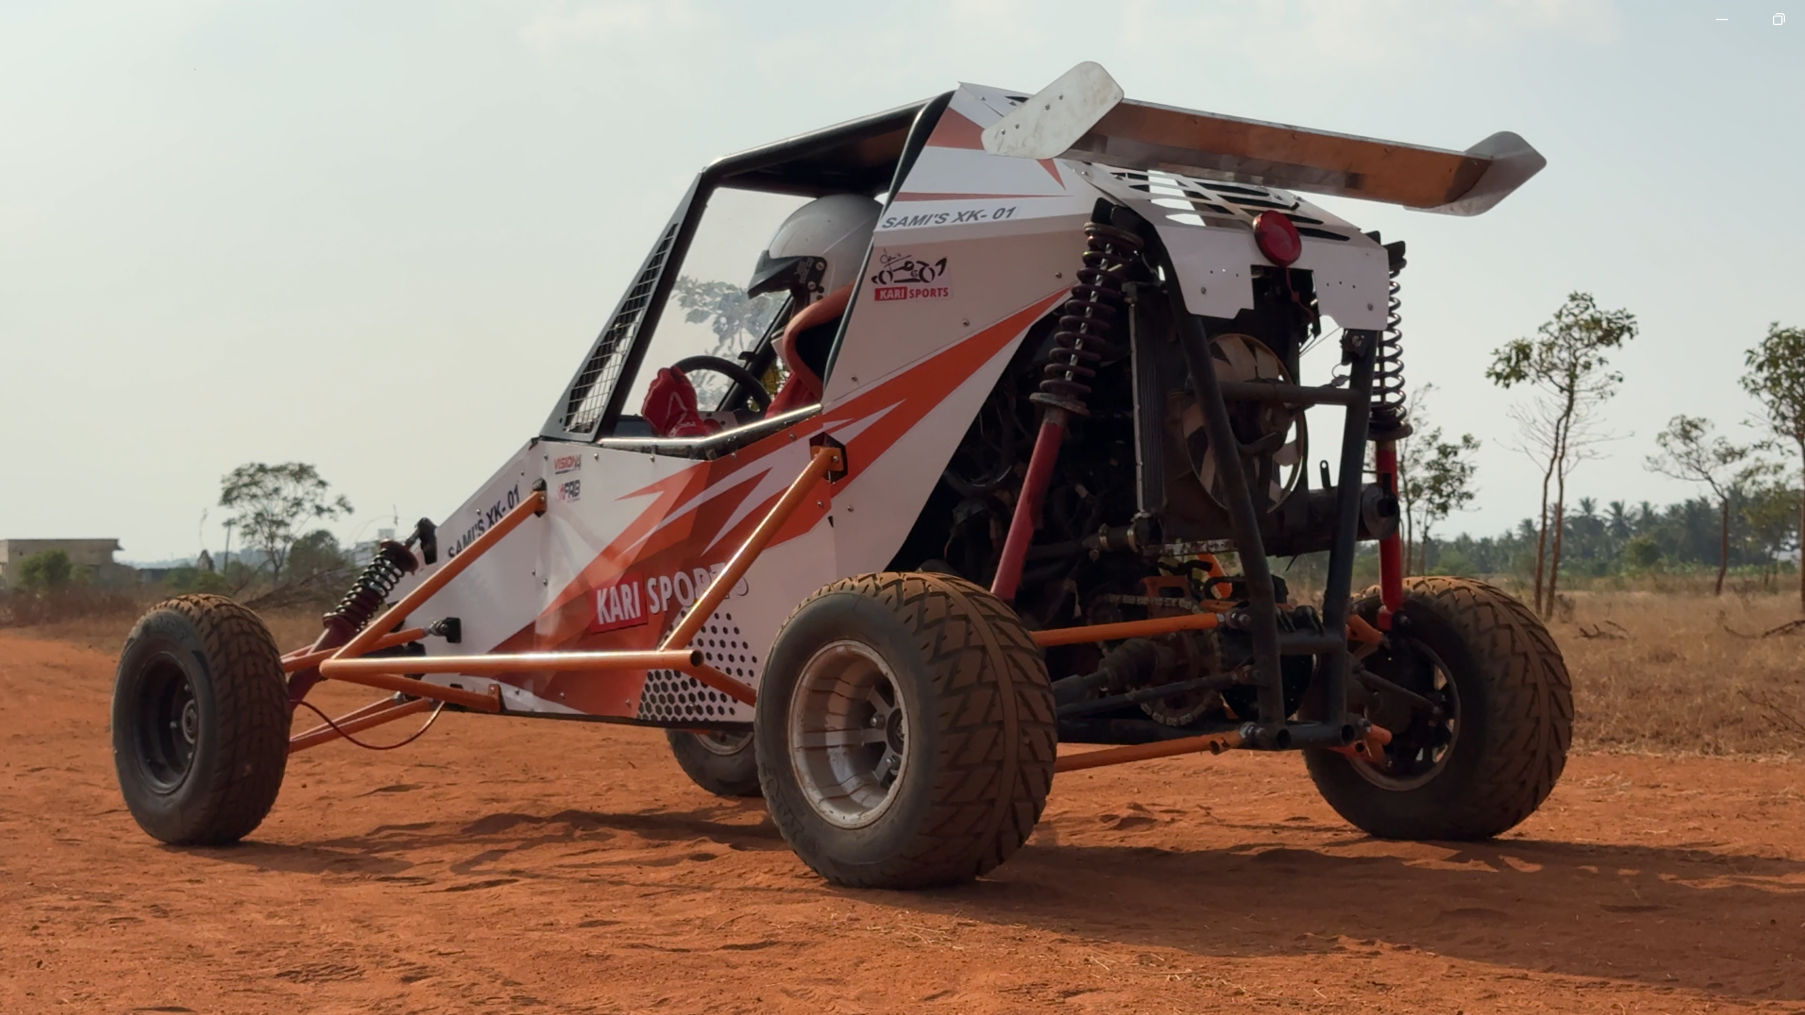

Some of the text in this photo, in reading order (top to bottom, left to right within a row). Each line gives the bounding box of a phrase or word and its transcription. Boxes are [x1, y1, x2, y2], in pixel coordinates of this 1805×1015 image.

[882, 206, 1017, 229] SAMI'S XK- 01
[880, 287, 949, 300] KARI SPORTS
[448, 519, 486, 558] SAMI'S
[507, 484, 520, 510] 01
[596, 581, 641, 625] KARI
